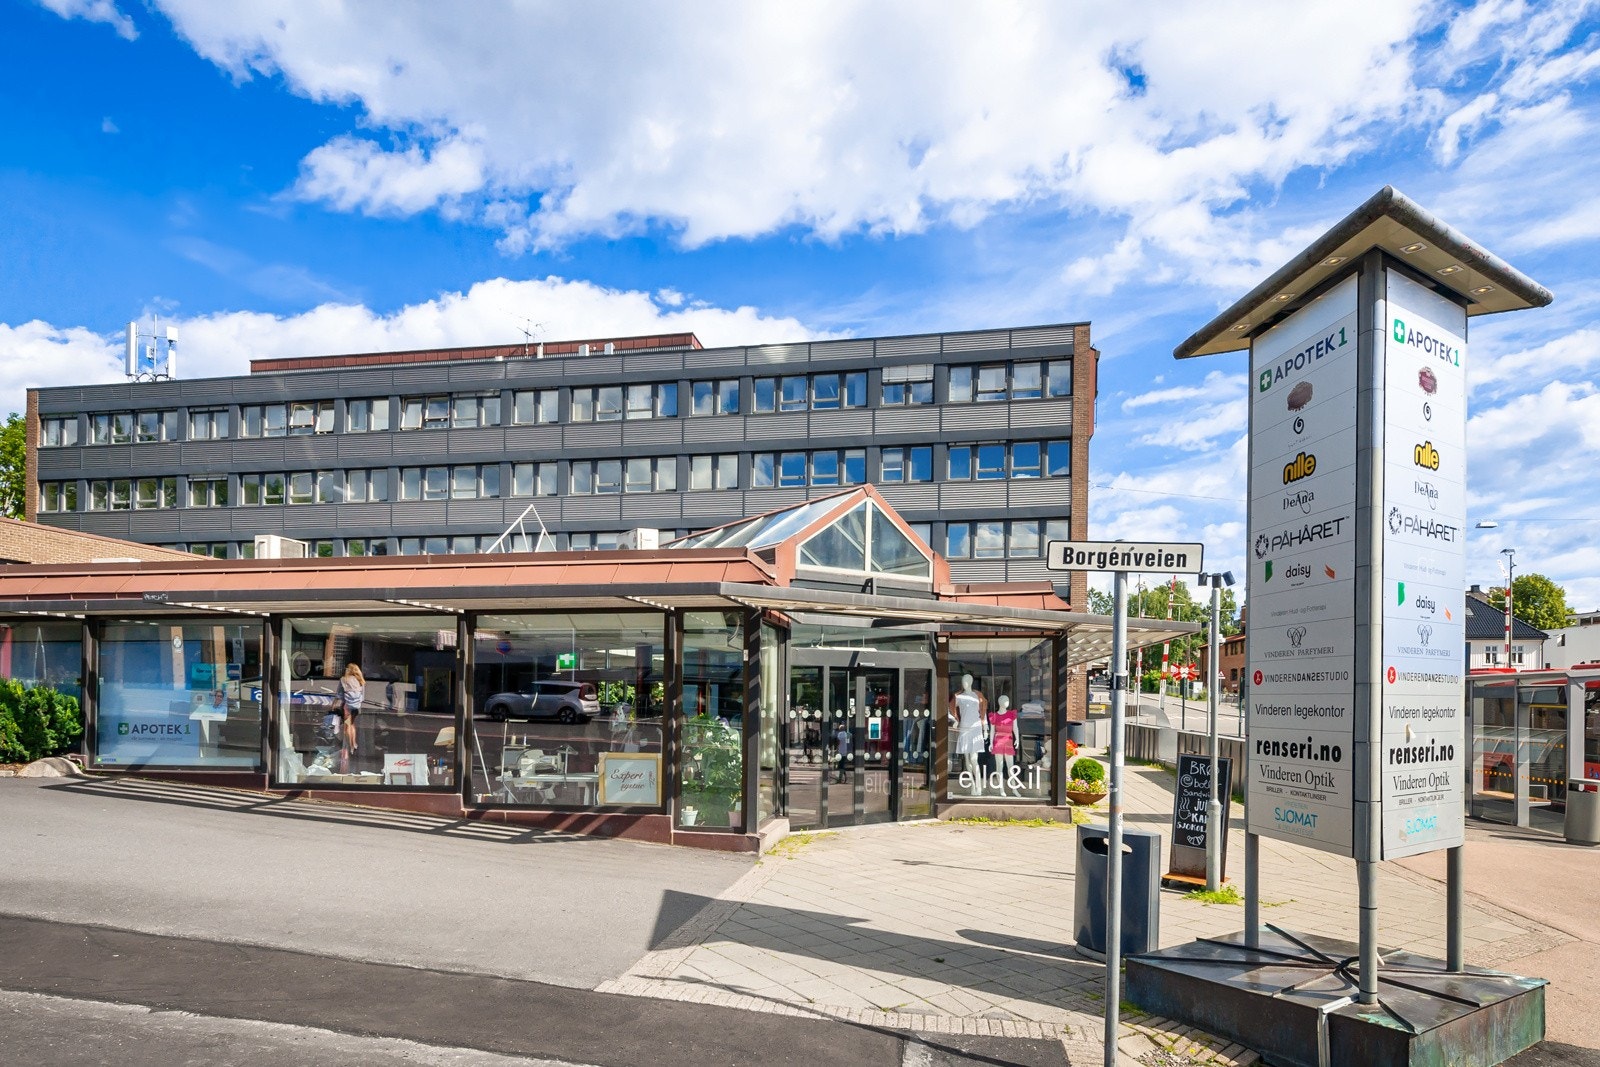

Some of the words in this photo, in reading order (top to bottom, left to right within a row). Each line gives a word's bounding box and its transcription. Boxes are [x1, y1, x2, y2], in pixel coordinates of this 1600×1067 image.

[1274, 333, 1336, 383] APOTEK
[1338, 327, 1348, 347] 1
[1407, 328, 1452, 363] APOTEK
[1454, 350, 1459, 367] 1
[1414, 440, 1439, 471] nille
[1283, 452, 1316, 485] nille
[1283, 490, 1315, 514] DeAna
[1272, 517, 1345, 552] PÅHÅRET
[1404, 515, 1457, 542] PÅHÅRET
[1285, 563, 1311, 578] daisy
[1415, 595, 1436, 613] daisy
[1264, 650, 1295, 658] VINDEREN
[1297, 646, 1334, 656] PARFYMERI
[1397, 646, 1424, 655] VINDEREN
[1255, 704, 1292, 716] Vinderen
[1294, 704, 1345, 720] legekontor
[1388, 706, 1420, 718] Vinderen
[1421, 706, 1456, 722] legekontor
[131, 724, 182, 735] APOTEK
[184, 724, 191, 735] 1
[1256, 736, 1342, 763] renseri.no
[1389, 738, 1454, 765] renseri.no
[610, 769, 644, 783] Expert
[958, 764, 1041, 790] ella&il
[1260, 764, 1302, 783] Vinderen
[1304, 769, 1335, 789] Optik
[1393, 774, 1427, 791] Vinderen
[1428, 771, 1450, 791] Optik
[1266, 785, 1283, 794] BRILLER
